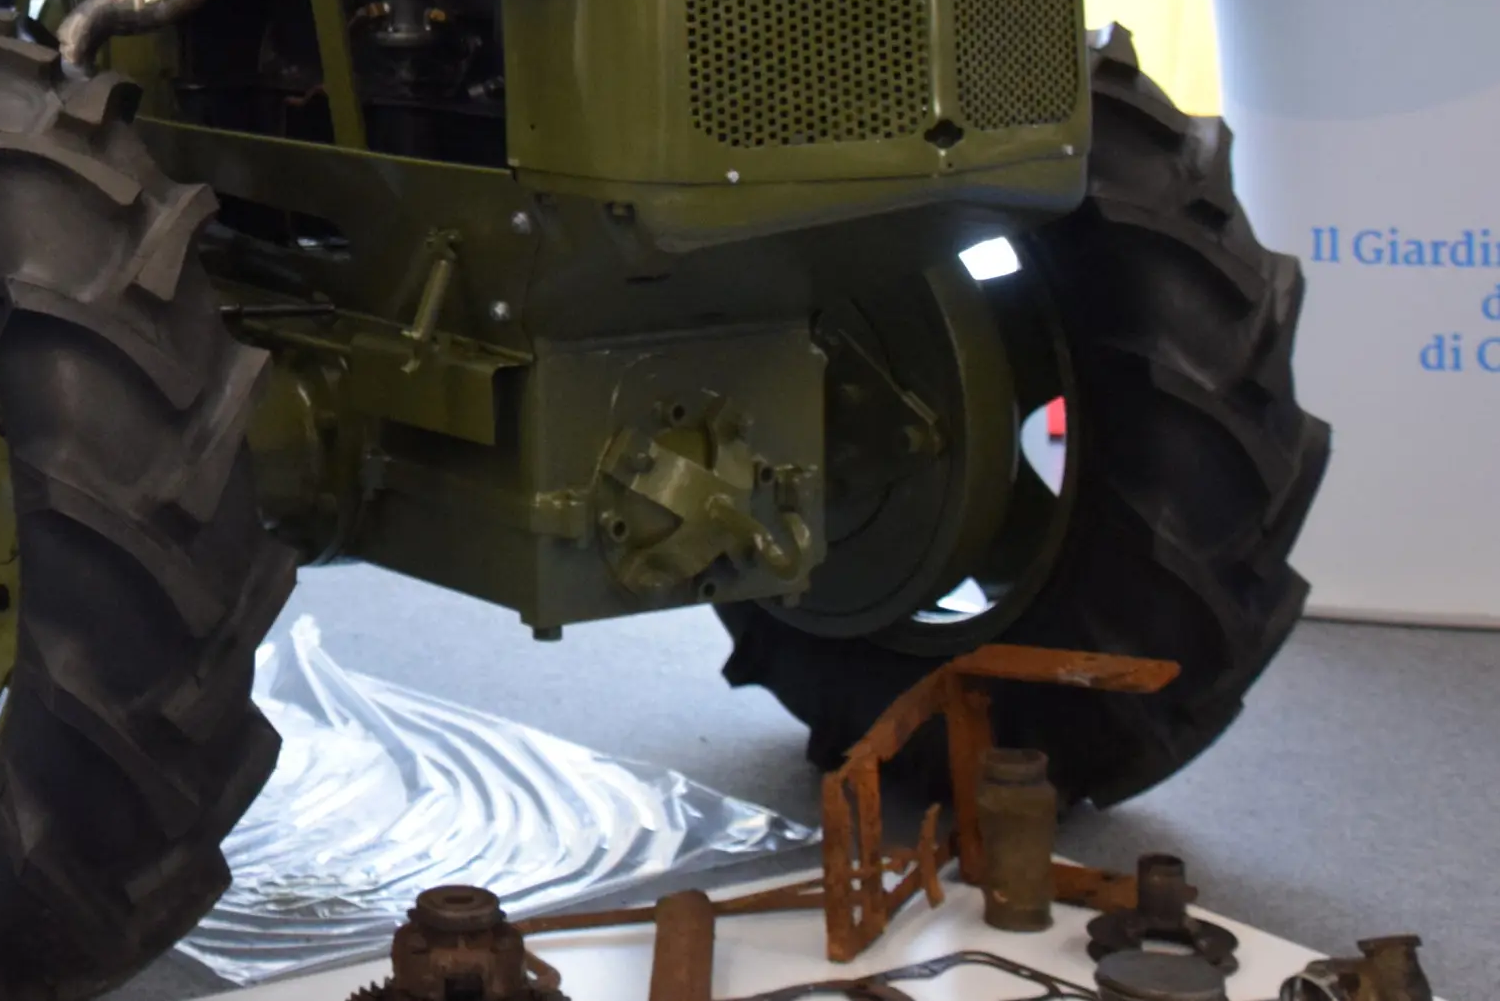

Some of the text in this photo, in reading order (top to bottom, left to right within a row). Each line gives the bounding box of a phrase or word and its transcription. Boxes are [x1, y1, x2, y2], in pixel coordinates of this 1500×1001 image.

[1311, 225, 1500, 267] Il Giardi
[1419, 334, 1462, 372] di
